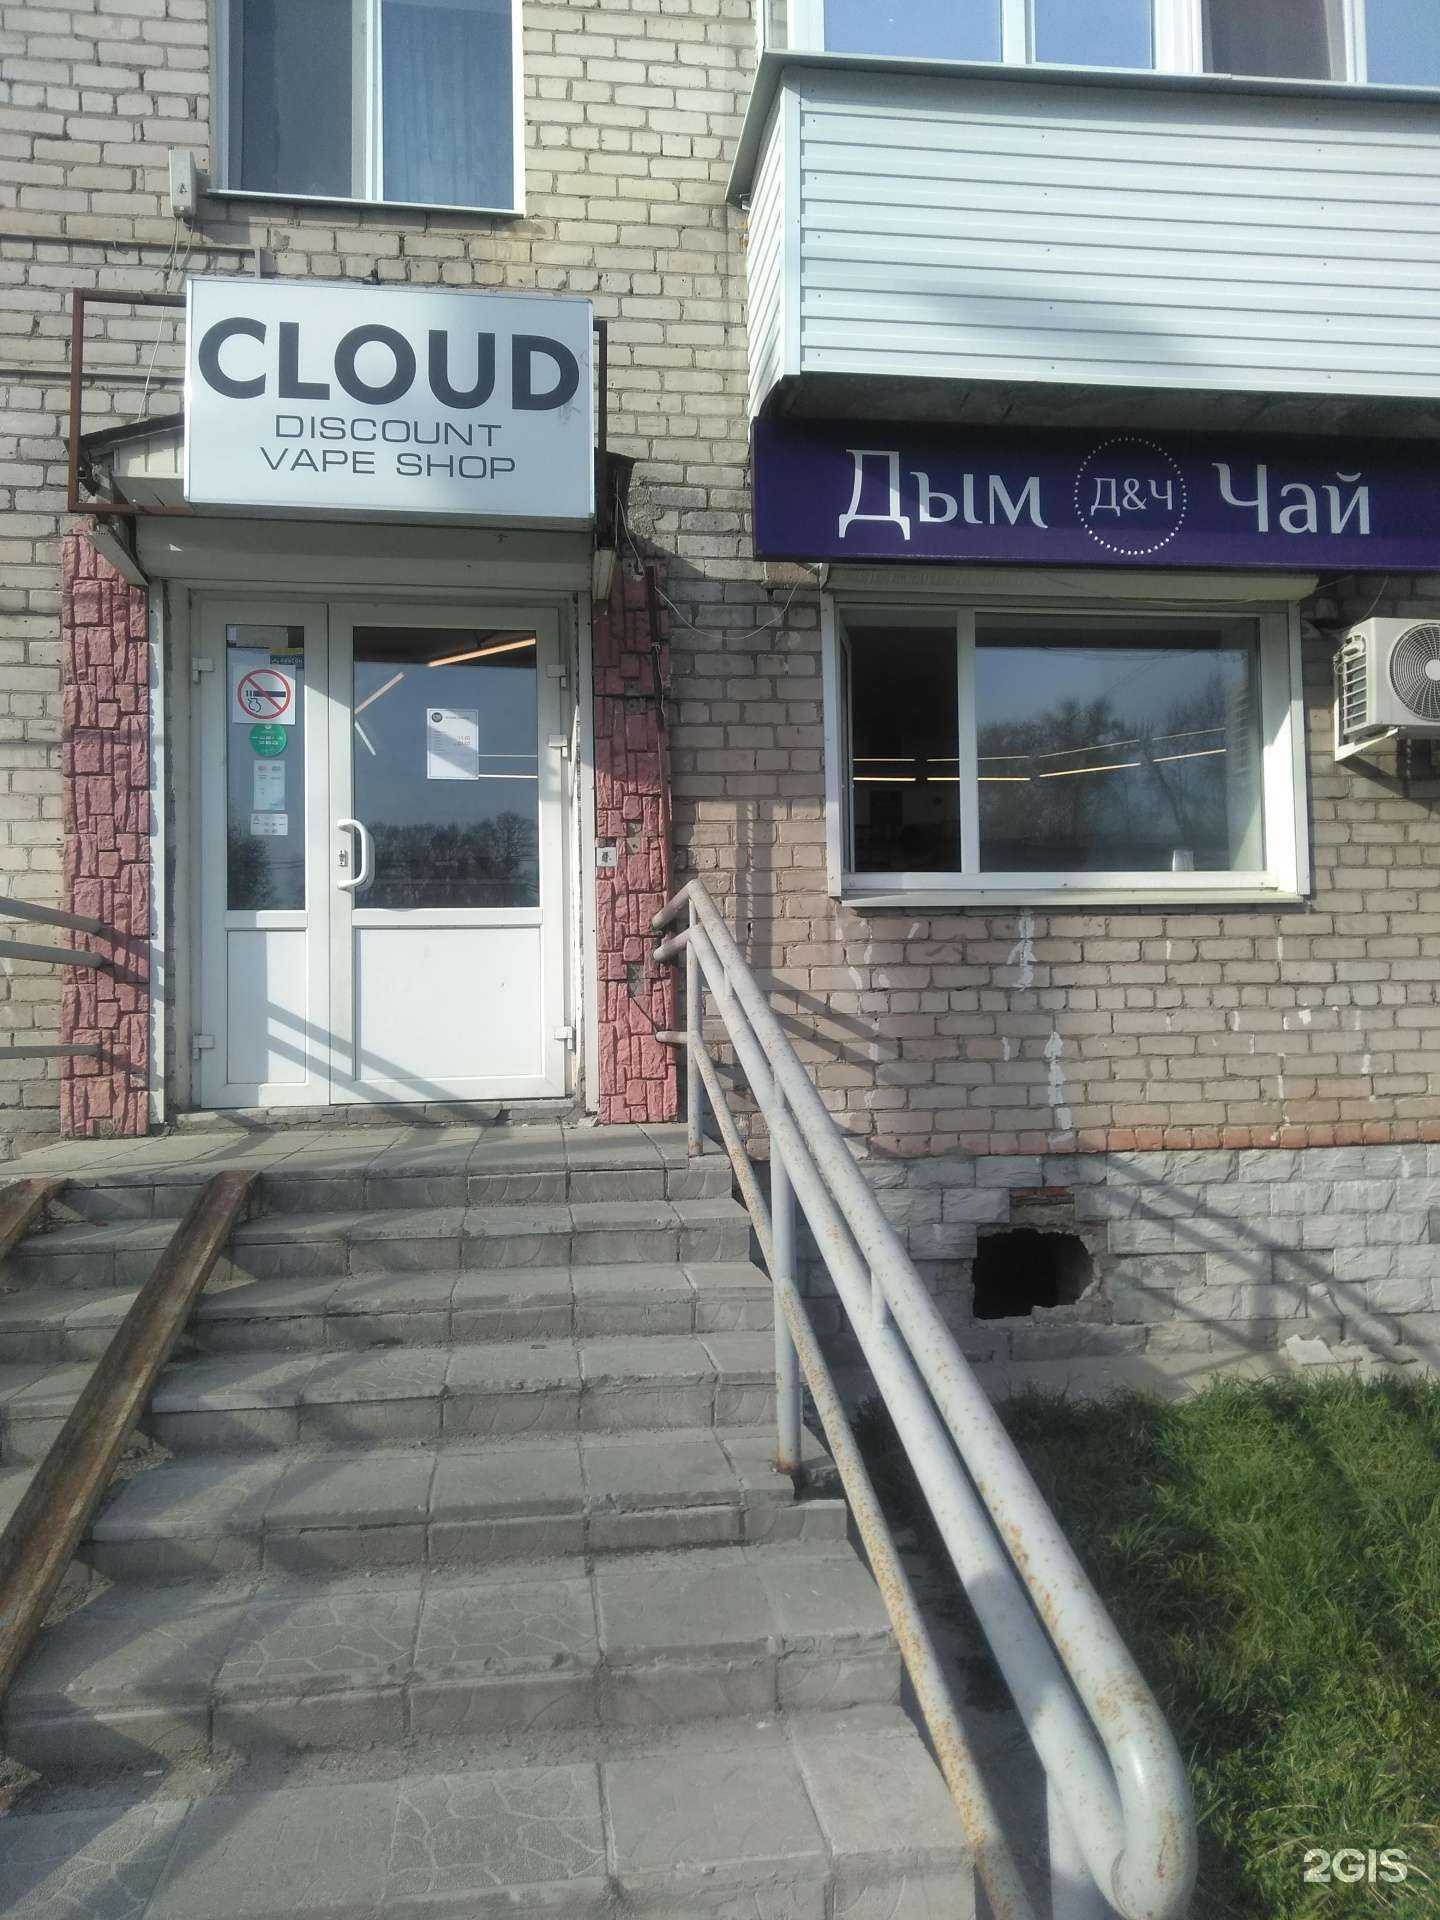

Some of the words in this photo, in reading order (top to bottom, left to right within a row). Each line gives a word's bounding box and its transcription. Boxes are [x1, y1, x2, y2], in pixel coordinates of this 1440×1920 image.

[198, 316, 580, 411] CLOUD
[275, 414, 502, 447] DISCOUNT
[260, 446, 376, 475] VAPE
[396, 453, 516, 480] SHOP
[838, 448, 1048, 541] Дым
[1090, 477, 1173, 517] Д&Ч
[1211, 462, 1371, 535] Чай
